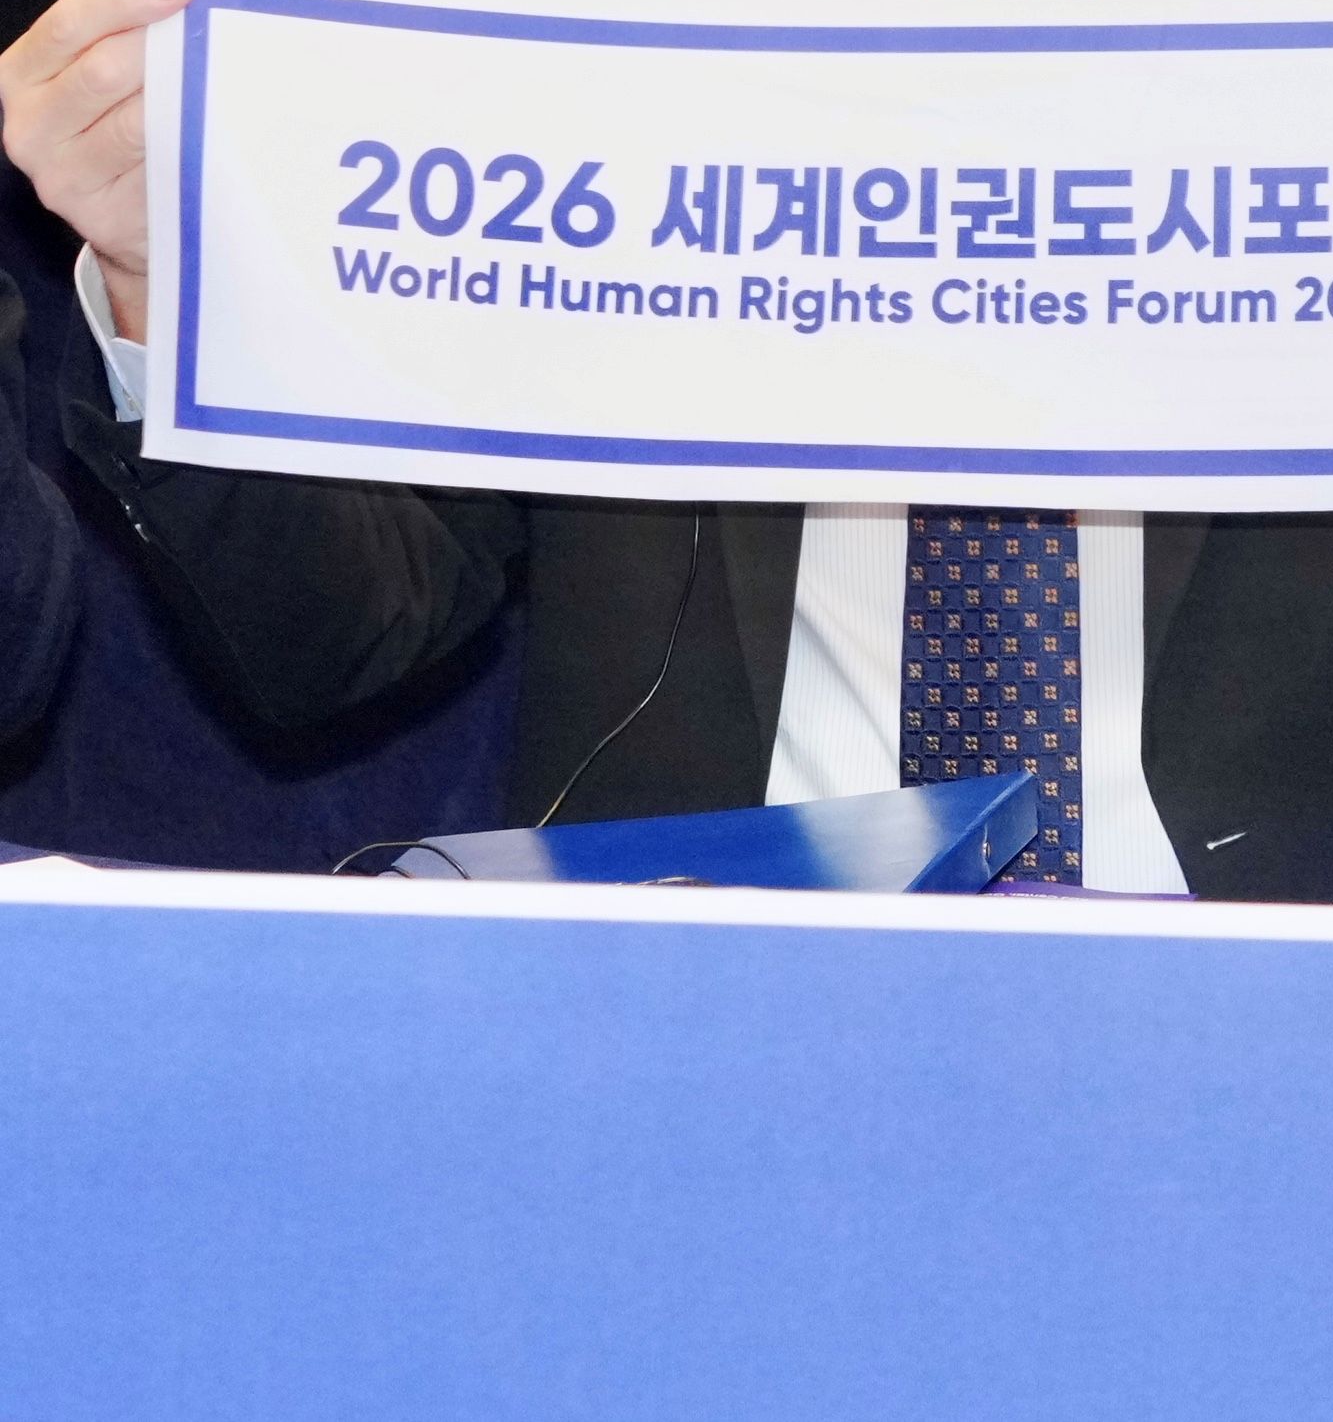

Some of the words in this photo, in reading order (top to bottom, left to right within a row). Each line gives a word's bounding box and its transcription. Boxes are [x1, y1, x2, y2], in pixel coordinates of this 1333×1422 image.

[337, 140, 616, 249] 2026
[332, 246, 501, 305] World
[520, 264, 720, 318] Human
[739, 275, 913, 334] Rights
[931, 278, 1089, 326] Cities
[1107, 278, 1278, 325] Forum
